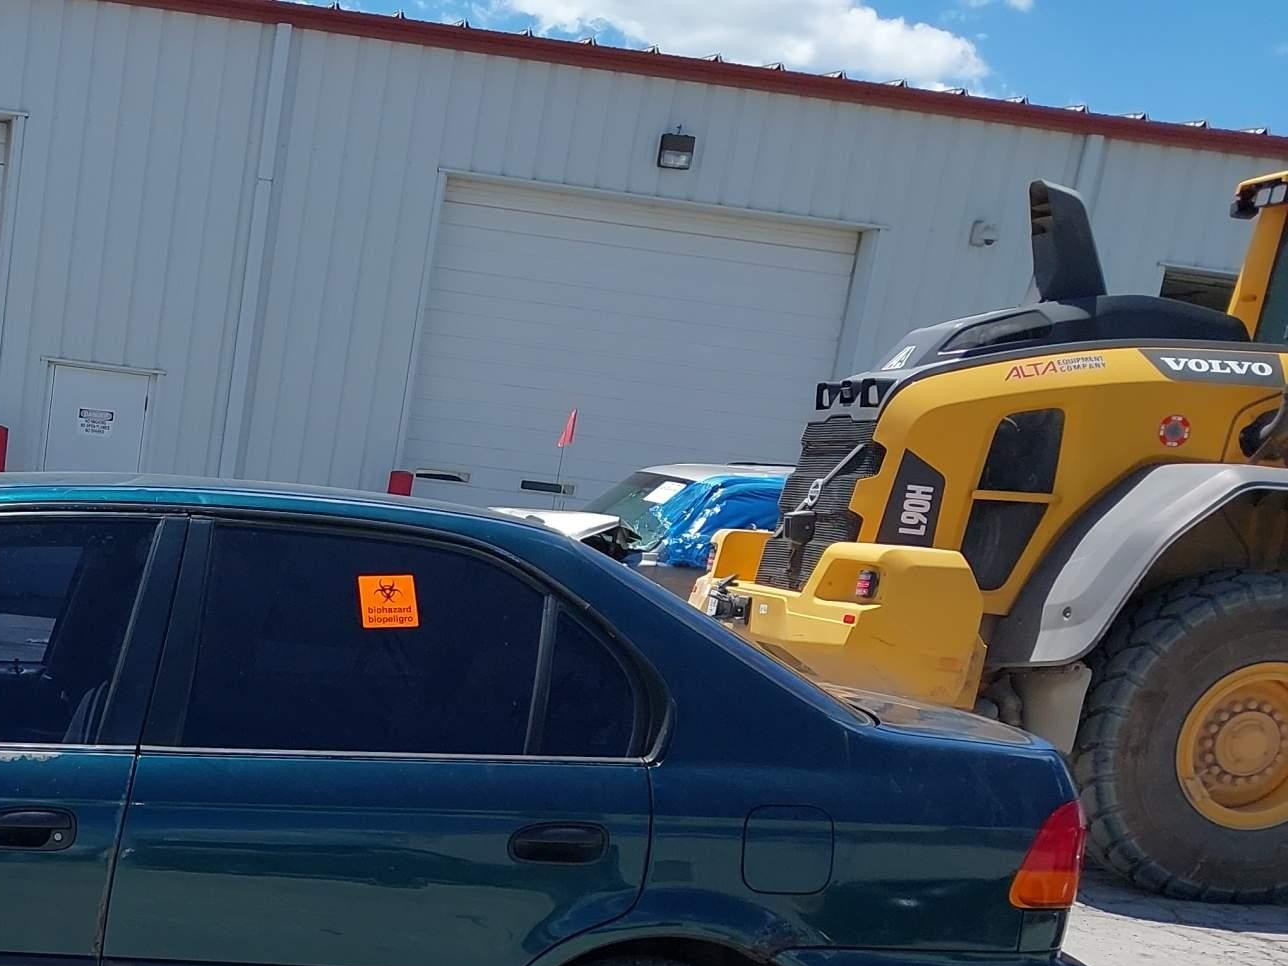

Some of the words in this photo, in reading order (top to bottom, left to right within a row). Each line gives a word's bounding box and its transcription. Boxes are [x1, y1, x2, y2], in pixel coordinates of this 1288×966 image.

[1004, 360, 1058, 381] ALTA
[1159, 356, 1273, 376] VOLVO
[898, 484, 935, 536] L90H
[367, 605, 412, 614] biohazard
[368, 615, 414, 624] biopeligro
